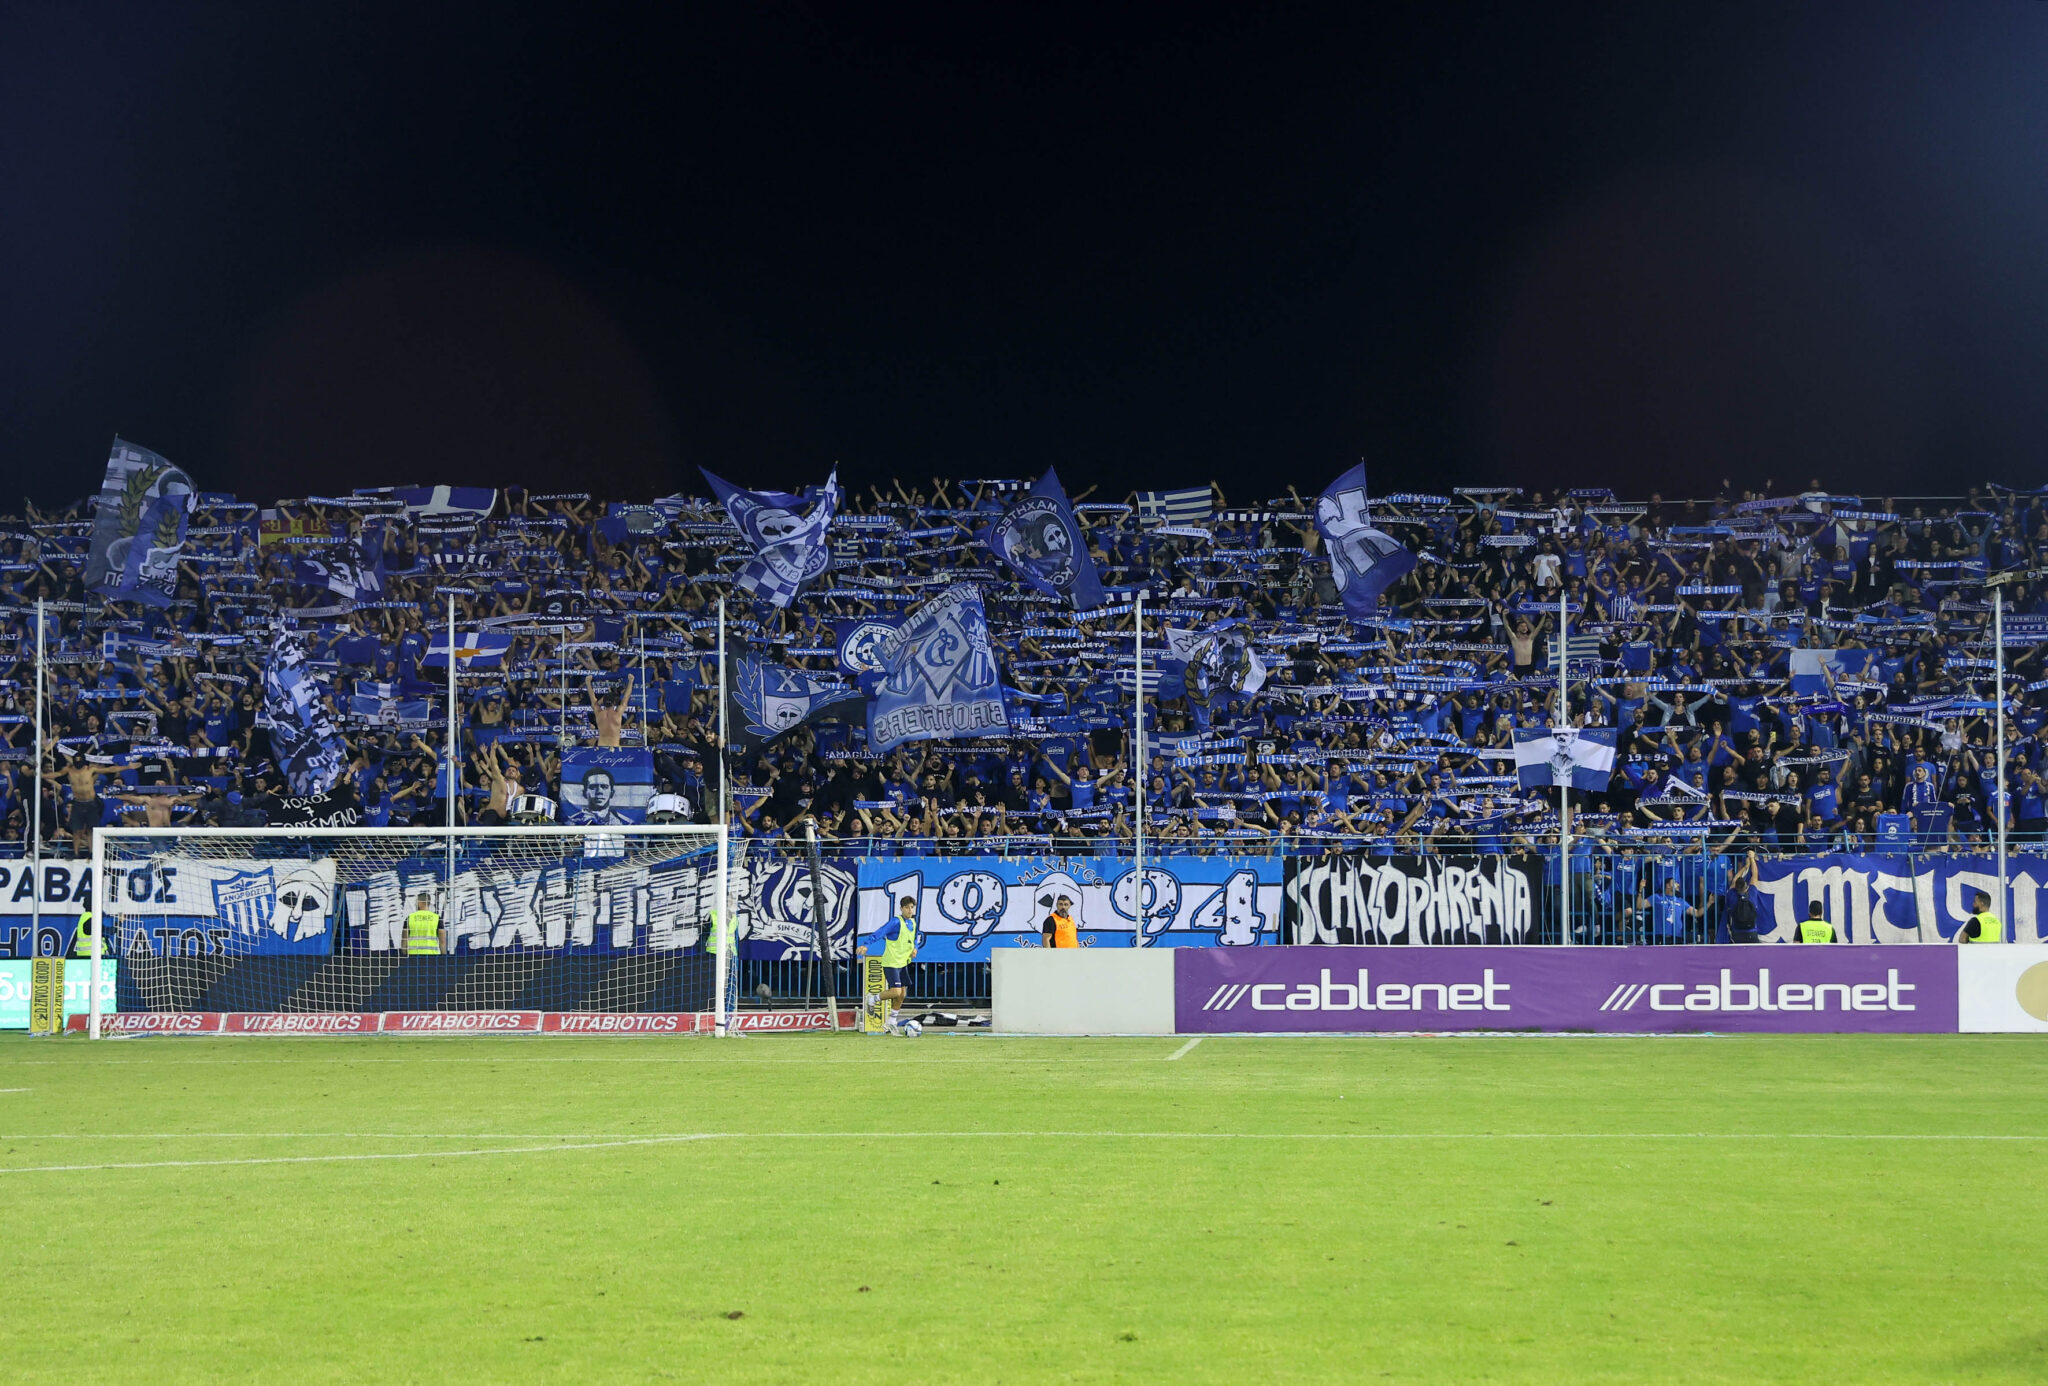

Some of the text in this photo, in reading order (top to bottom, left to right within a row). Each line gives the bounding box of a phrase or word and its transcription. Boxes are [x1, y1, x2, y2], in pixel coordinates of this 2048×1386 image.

[1628, 753, 1668, 762] 19 94
[1655, 820, 1740, 828] FAMAGUSTA
[1286, 856, 1532, 945] SCHIZOPHRENIA
[883, 867, 1265, 952] 19 94
[778, 924, 800, 934] SINCE
[36, 961, 50, 984] GROUP
[868, 959, 883, 983] GROUP
[1251, 968, 1511, 1011] cablenet
[1649, 968, 1916, 1011] cablenet
[86, 1014, 203, 1031] TABIOTICS
[242, 1014, 363, 1031] VITABIOTICS
[401, 1014, 523, 1031] VITABIOTICS
[559, 1015, 679, 1031] VITABIOTICS
[727, 1013, 832, 1030] ITABIOTICS
